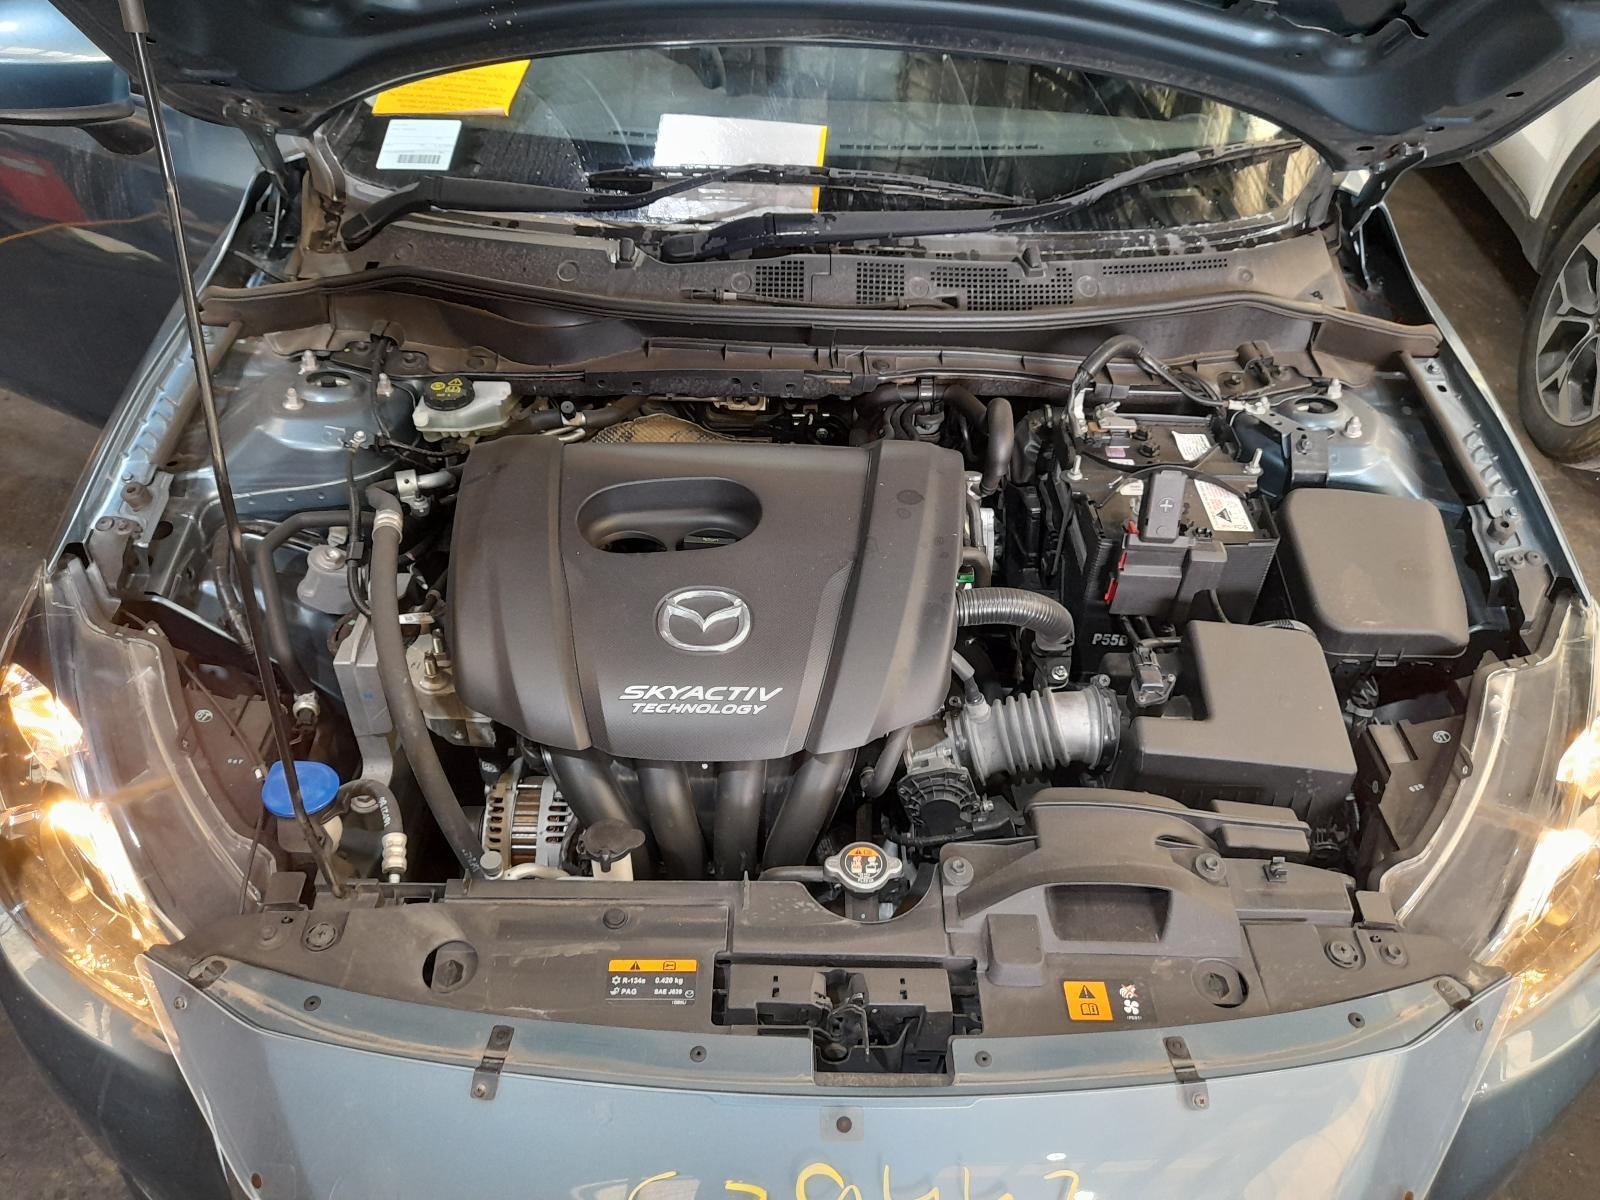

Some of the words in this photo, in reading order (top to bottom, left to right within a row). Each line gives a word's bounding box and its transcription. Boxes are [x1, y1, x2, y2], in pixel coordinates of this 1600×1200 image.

[618, 685, 784, 702] SKYACTIV
[632, 702, 768, 715] TECHNOLOGY
[621, 988, 637, 996] PAG
